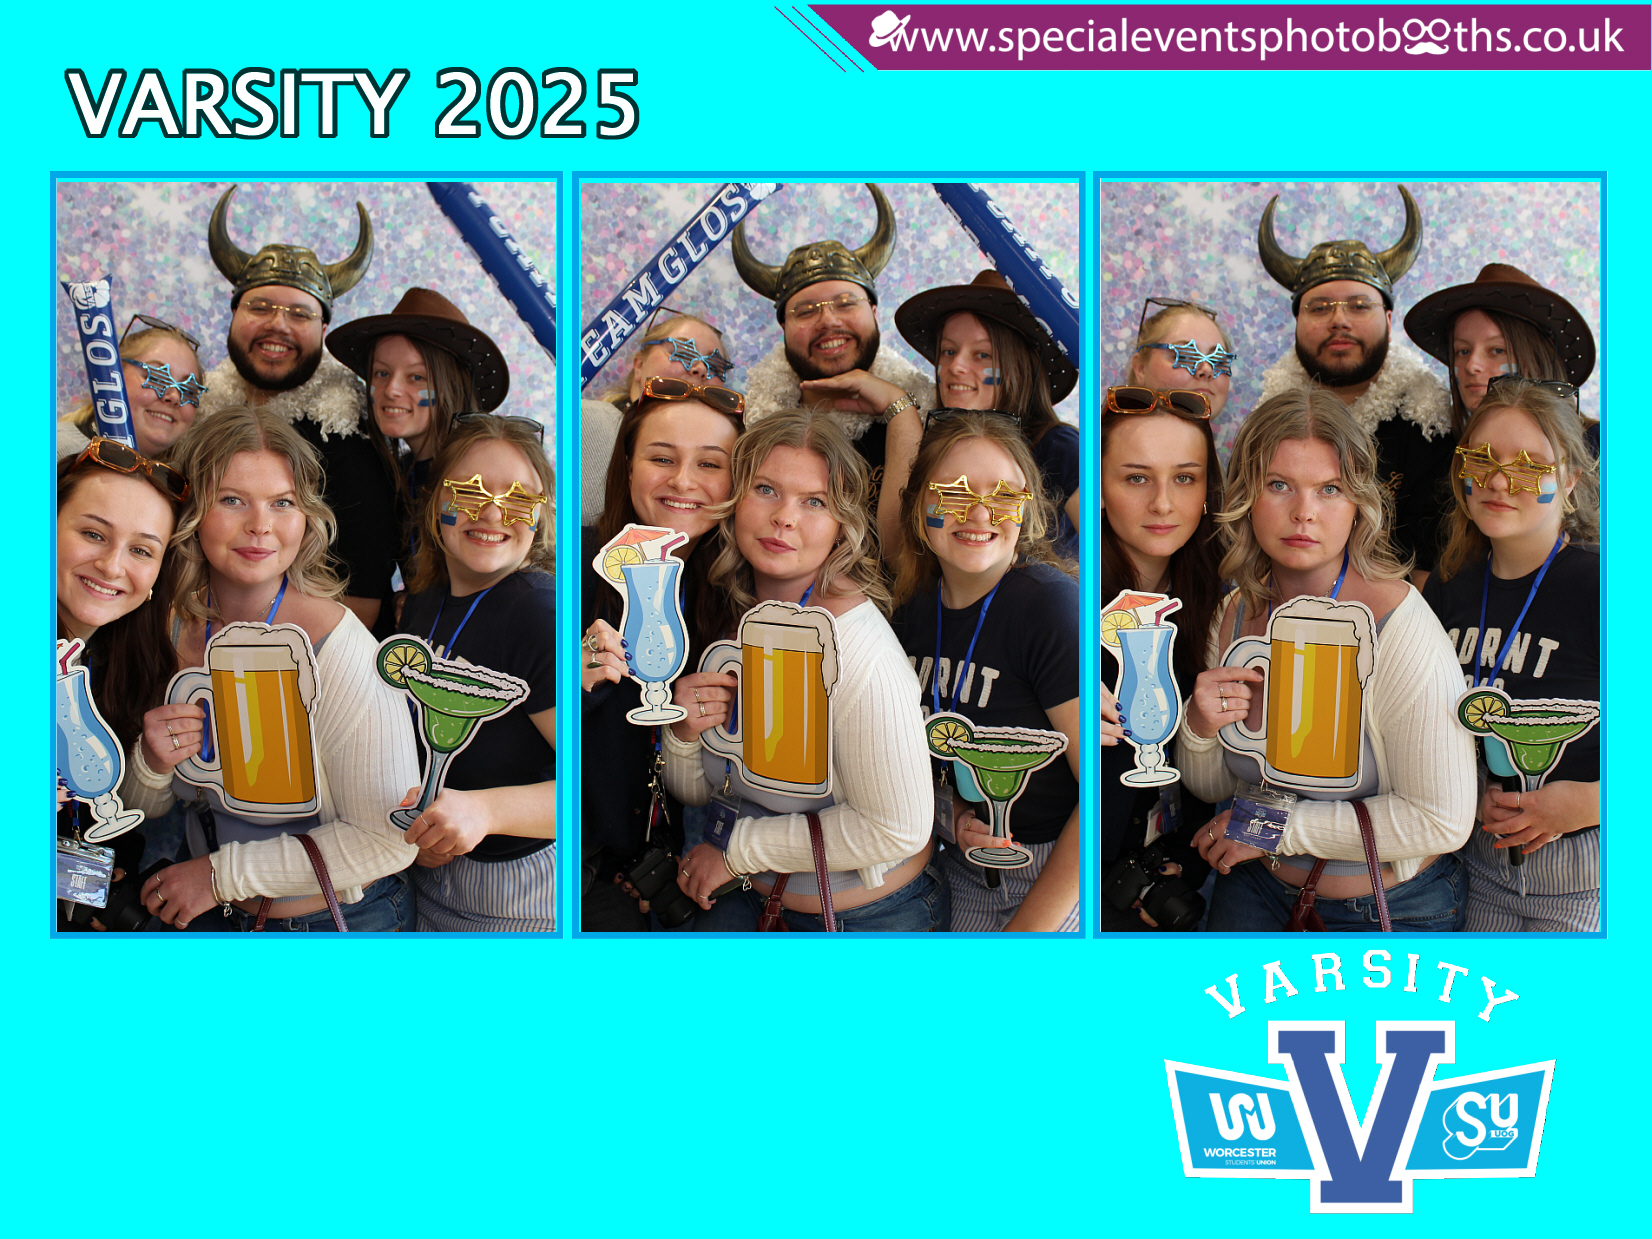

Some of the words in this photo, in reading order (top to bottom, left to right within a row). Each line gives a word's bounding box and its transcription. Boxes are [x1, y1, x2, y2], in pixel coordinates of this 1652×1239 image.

[658, 182, 748, 284] GLOS
[80, 313, 128, 425] GLOS
[70, 873, 88, 890] STAFF
